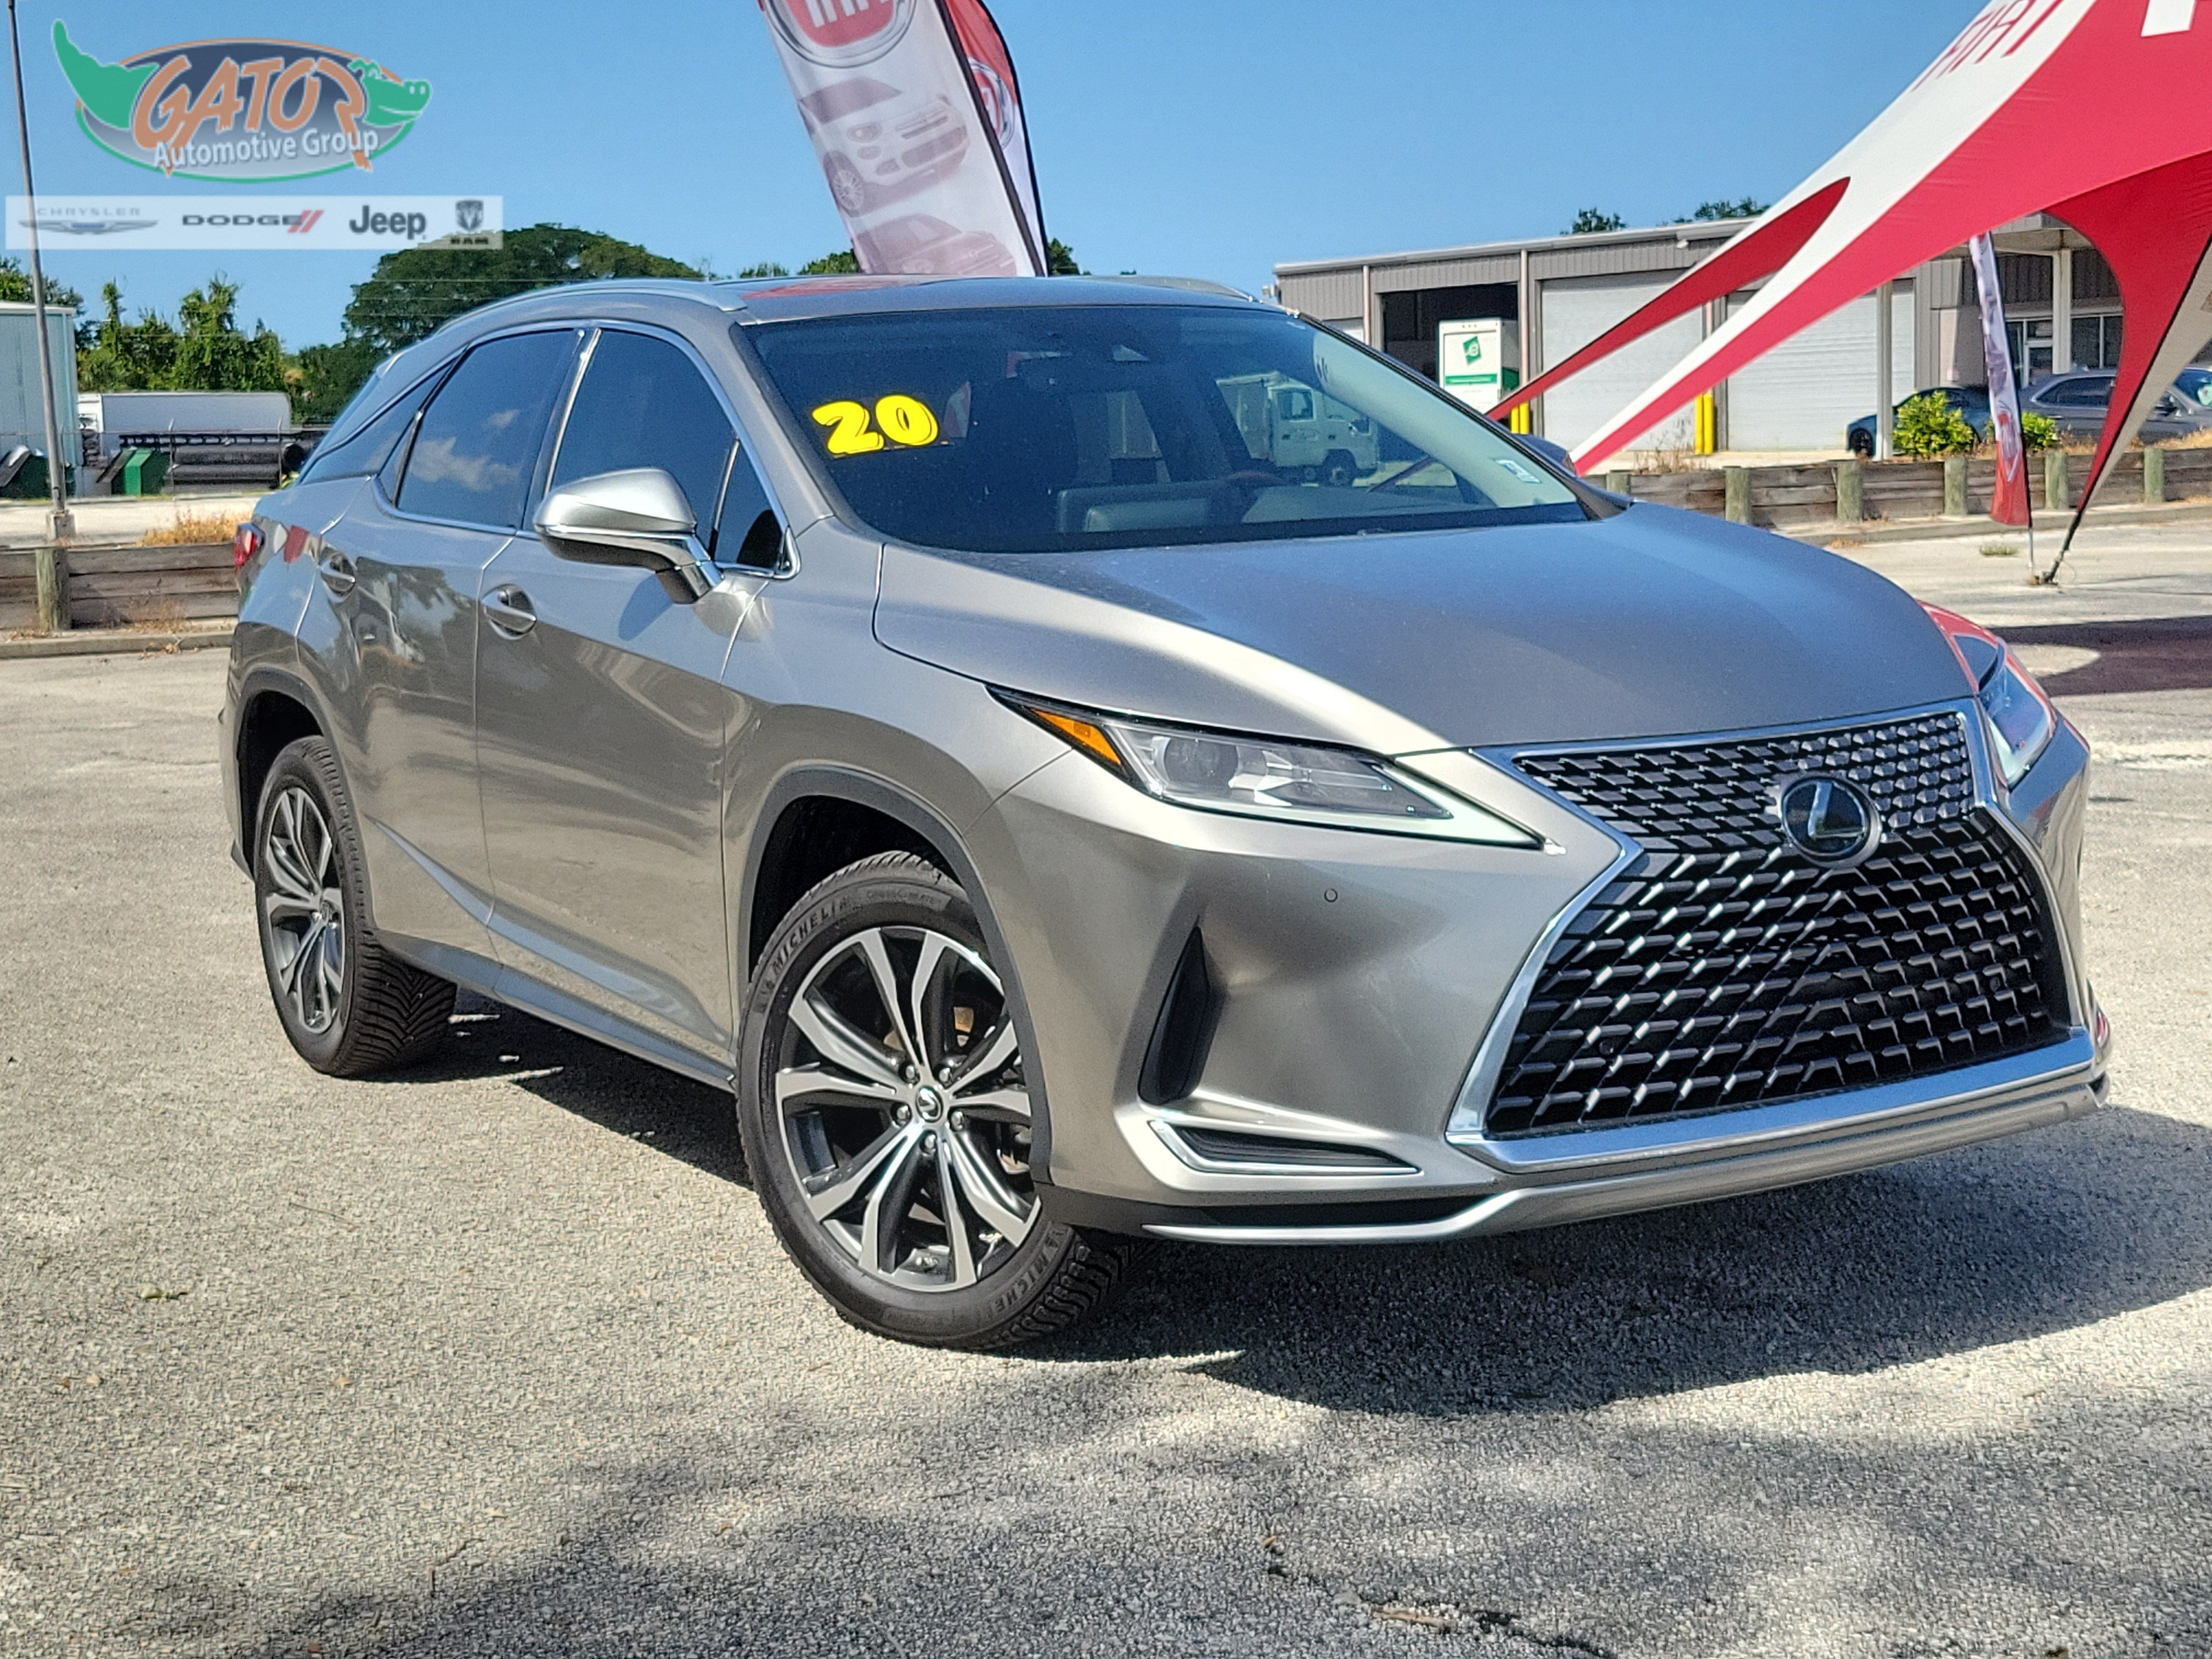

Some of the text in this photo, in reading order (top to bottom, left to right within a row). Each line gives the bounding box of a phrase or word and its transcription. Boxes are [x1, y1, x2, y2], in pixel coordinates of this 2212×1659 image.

[811, 394, 939, 454] 20
[771, 894, 855, 976] MICHELIN
[974, 1252, 1049, 1321] MICHE
